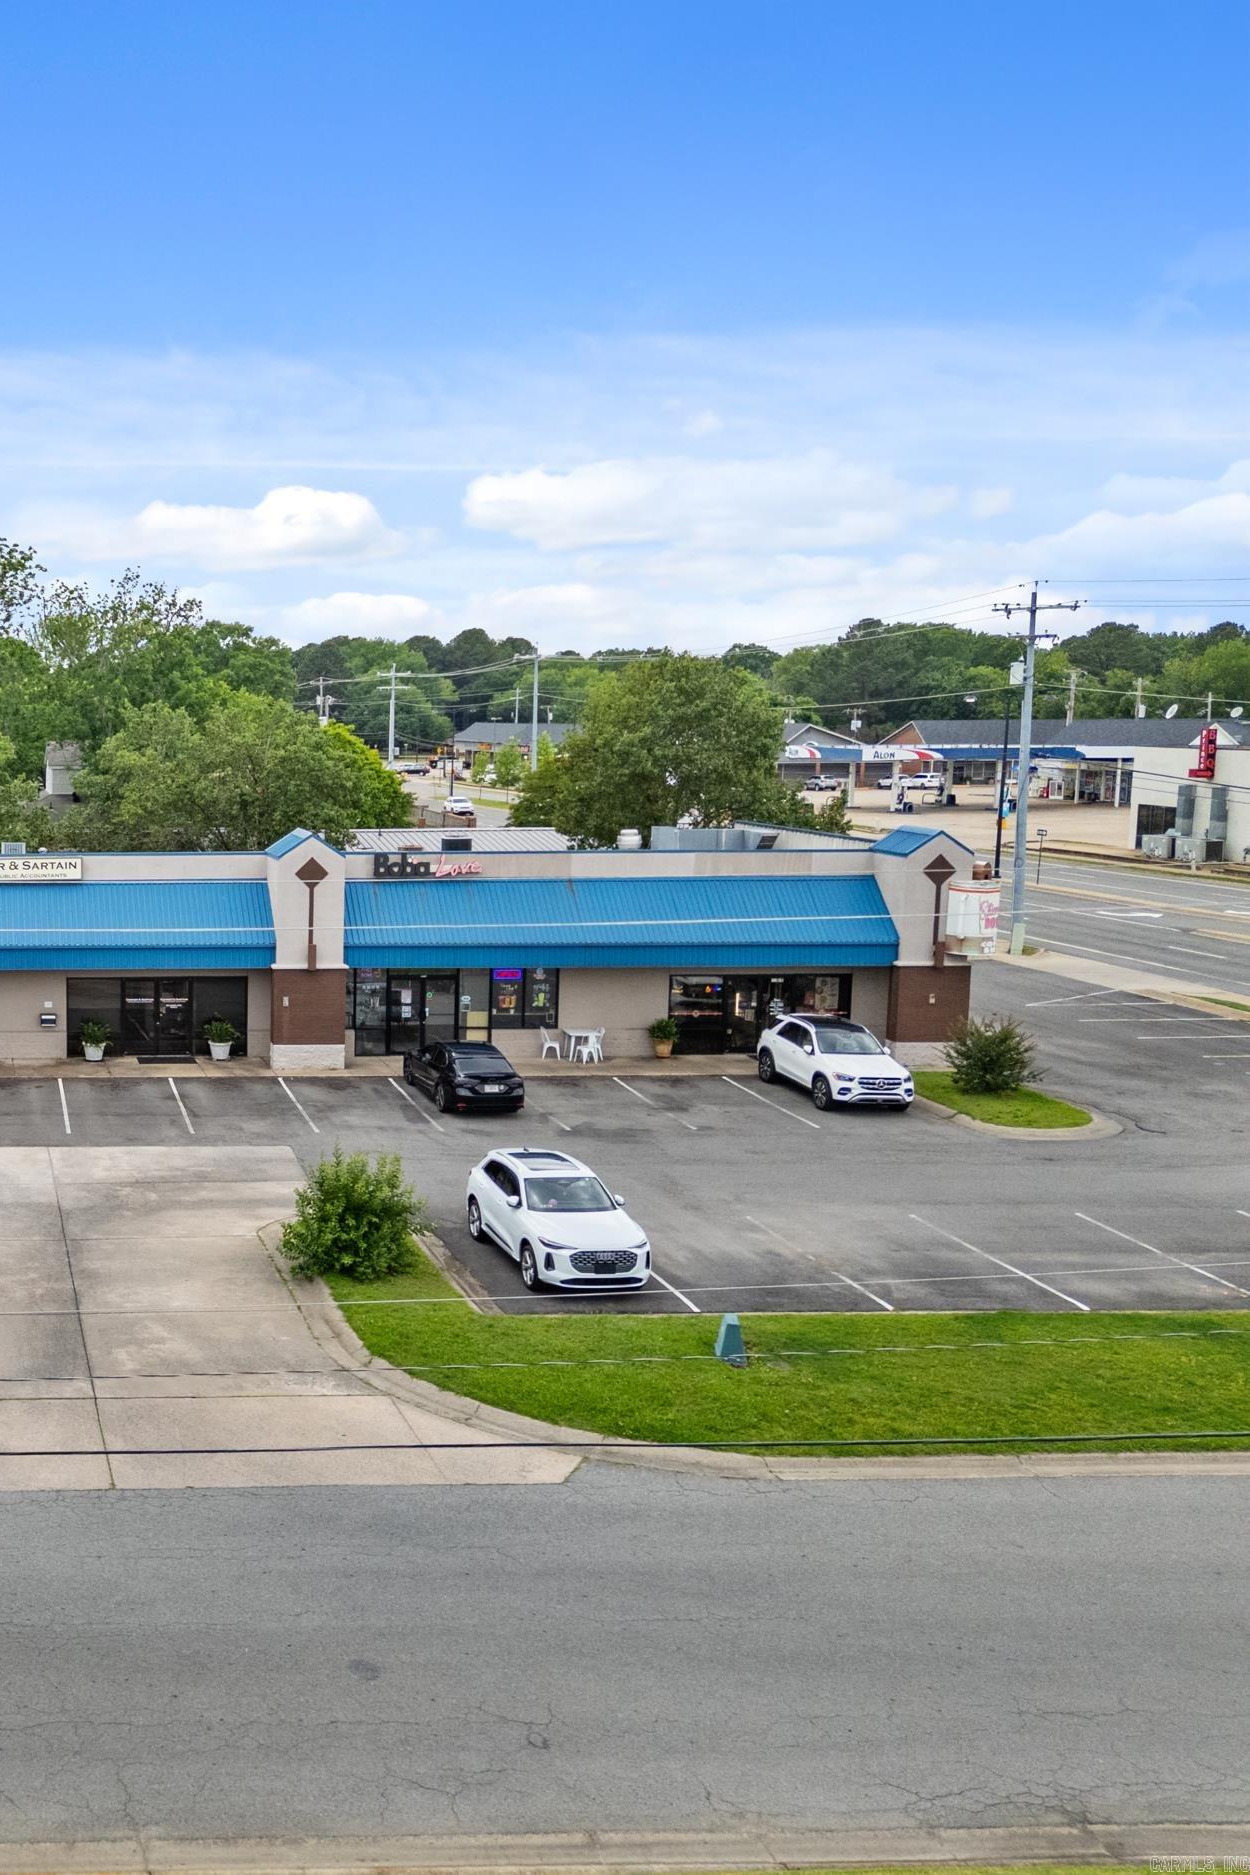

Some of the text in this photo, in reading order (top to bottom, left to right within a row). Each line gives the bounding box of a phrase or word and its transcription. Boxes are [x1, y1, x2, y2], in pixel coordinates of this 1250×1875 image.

[1207, 730, 1215, 768] BBQ
[8, 861, 19, 871] &
[22, 860, 77, 871] SARTAIN
[374, 852, 482, 878] Boba Love
